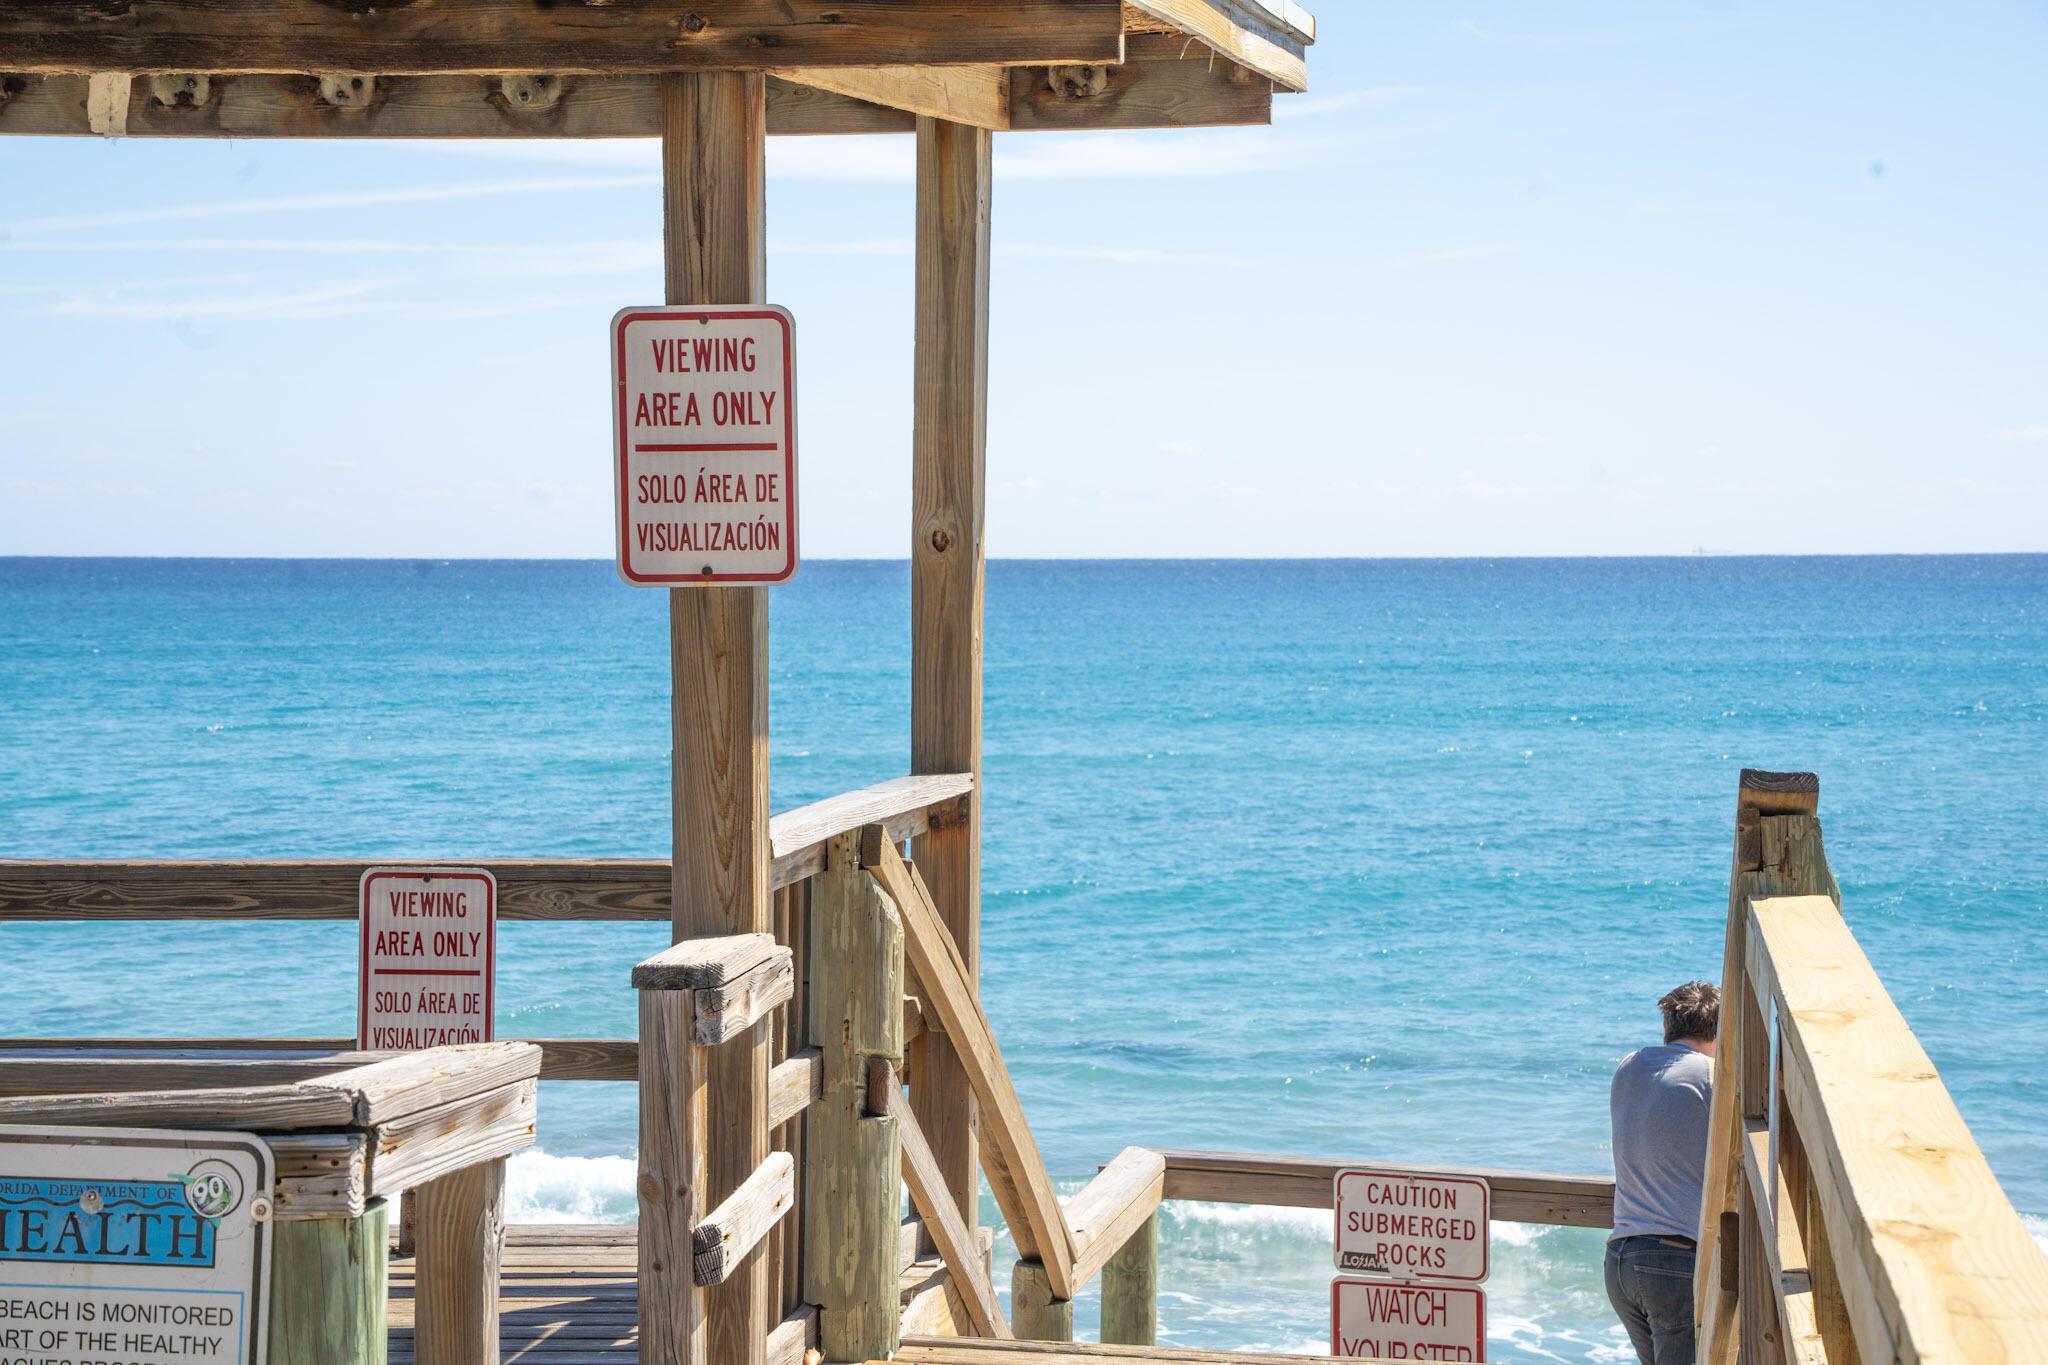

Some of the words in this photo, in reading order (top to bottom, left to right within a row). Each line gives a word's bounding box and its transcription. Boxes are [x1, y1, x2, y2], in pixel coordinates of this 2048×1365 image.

[652, 338, 756, 373] VIEWING
[635, 393, 701, 426] AREA
[713, 391, 776, 426] ONLY
[638, 474, 686, 504] SOLO
[694, 467, 748, 503] ÁREA
[755, 473, 779, 503] DE
[636, 514, 780, 552] VISUALIZACIÓN
[390, 891, 467, 918] VIEWING
[374, 931, 425, 957] AREA
[433, 931, 481, 957] ONLY
[374, 991, 411, 1013] SOLO
[417, 986, 457, 1014] ÁREA
[463, 993, 480, 1014] DE
[373, 1022, 480, 1050] VISUALIZACIÓN
[0, 1182, 40, 1196] RIDA
[157, 1187, 177, 1200] OF
[1368, 1183, 1457, 1209] CAUTION
[0, 1209, 207, 1259] EALTH
[1348, 1211, 1476, 1241] SUBMERGED
[1377, 1242, 1446, 1268] ROCKS
[76, 1302, 95, 1321] IS
[103, 1303, 234, 1327] MONITORED
[1366, 1287, 1447, 1327] WATCH
[39, 1330, 69, 1350] OF
[75, 1331, 117, 1352] THE
[125, 1333, 222, 1356] HEALTHY
